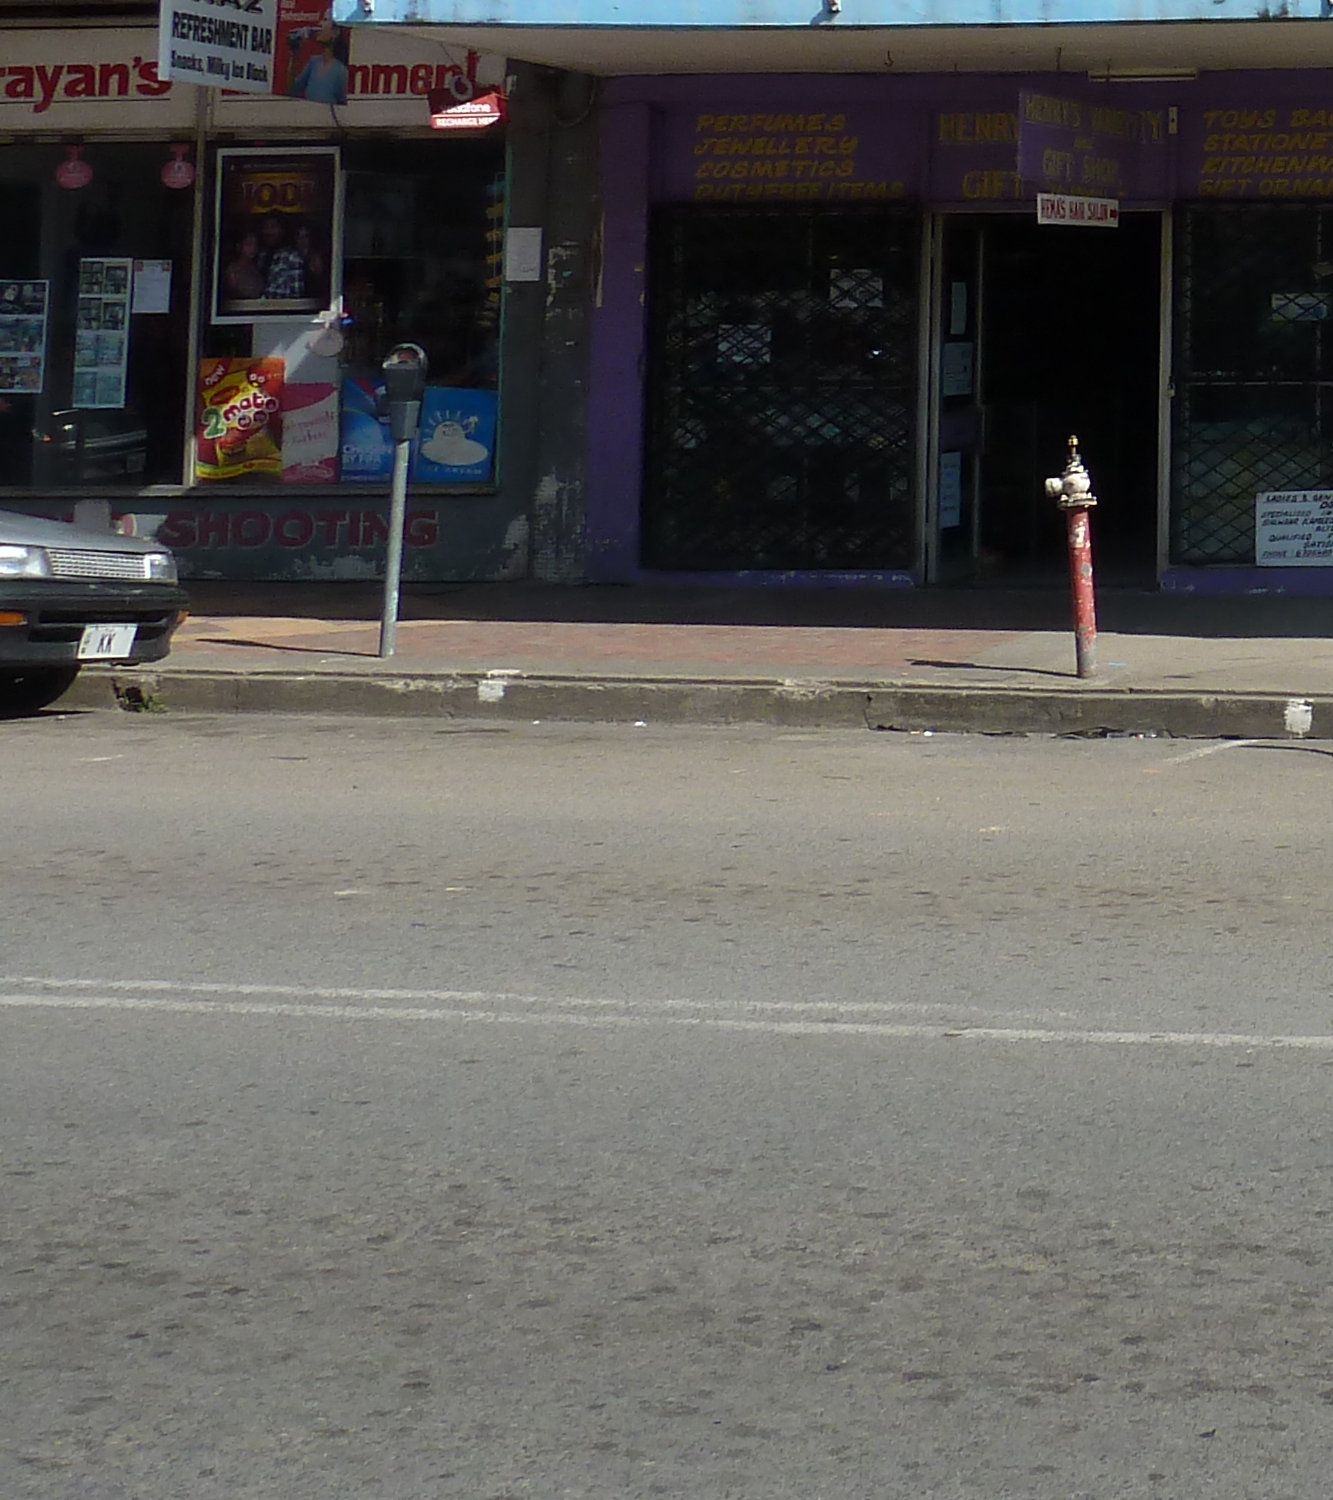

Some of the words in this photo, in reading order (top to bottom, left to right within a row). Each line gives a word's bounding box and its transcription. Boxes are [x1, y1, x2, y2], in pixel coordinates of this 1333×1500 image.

[171, 10, 249, 51] REFRESHMENT
[250, 25, 273, 55] BAR
[0, 56, 172, 113] ayan's
[695, 112, 846, 133] PERFUMES
[1203, 108, 1277, 129] TOYS
[694, 136, 859, 156] JEWELLERY
[694, 159, 857, 179] COSMETICS
[158, 509, 440, 548] SHOOTING
